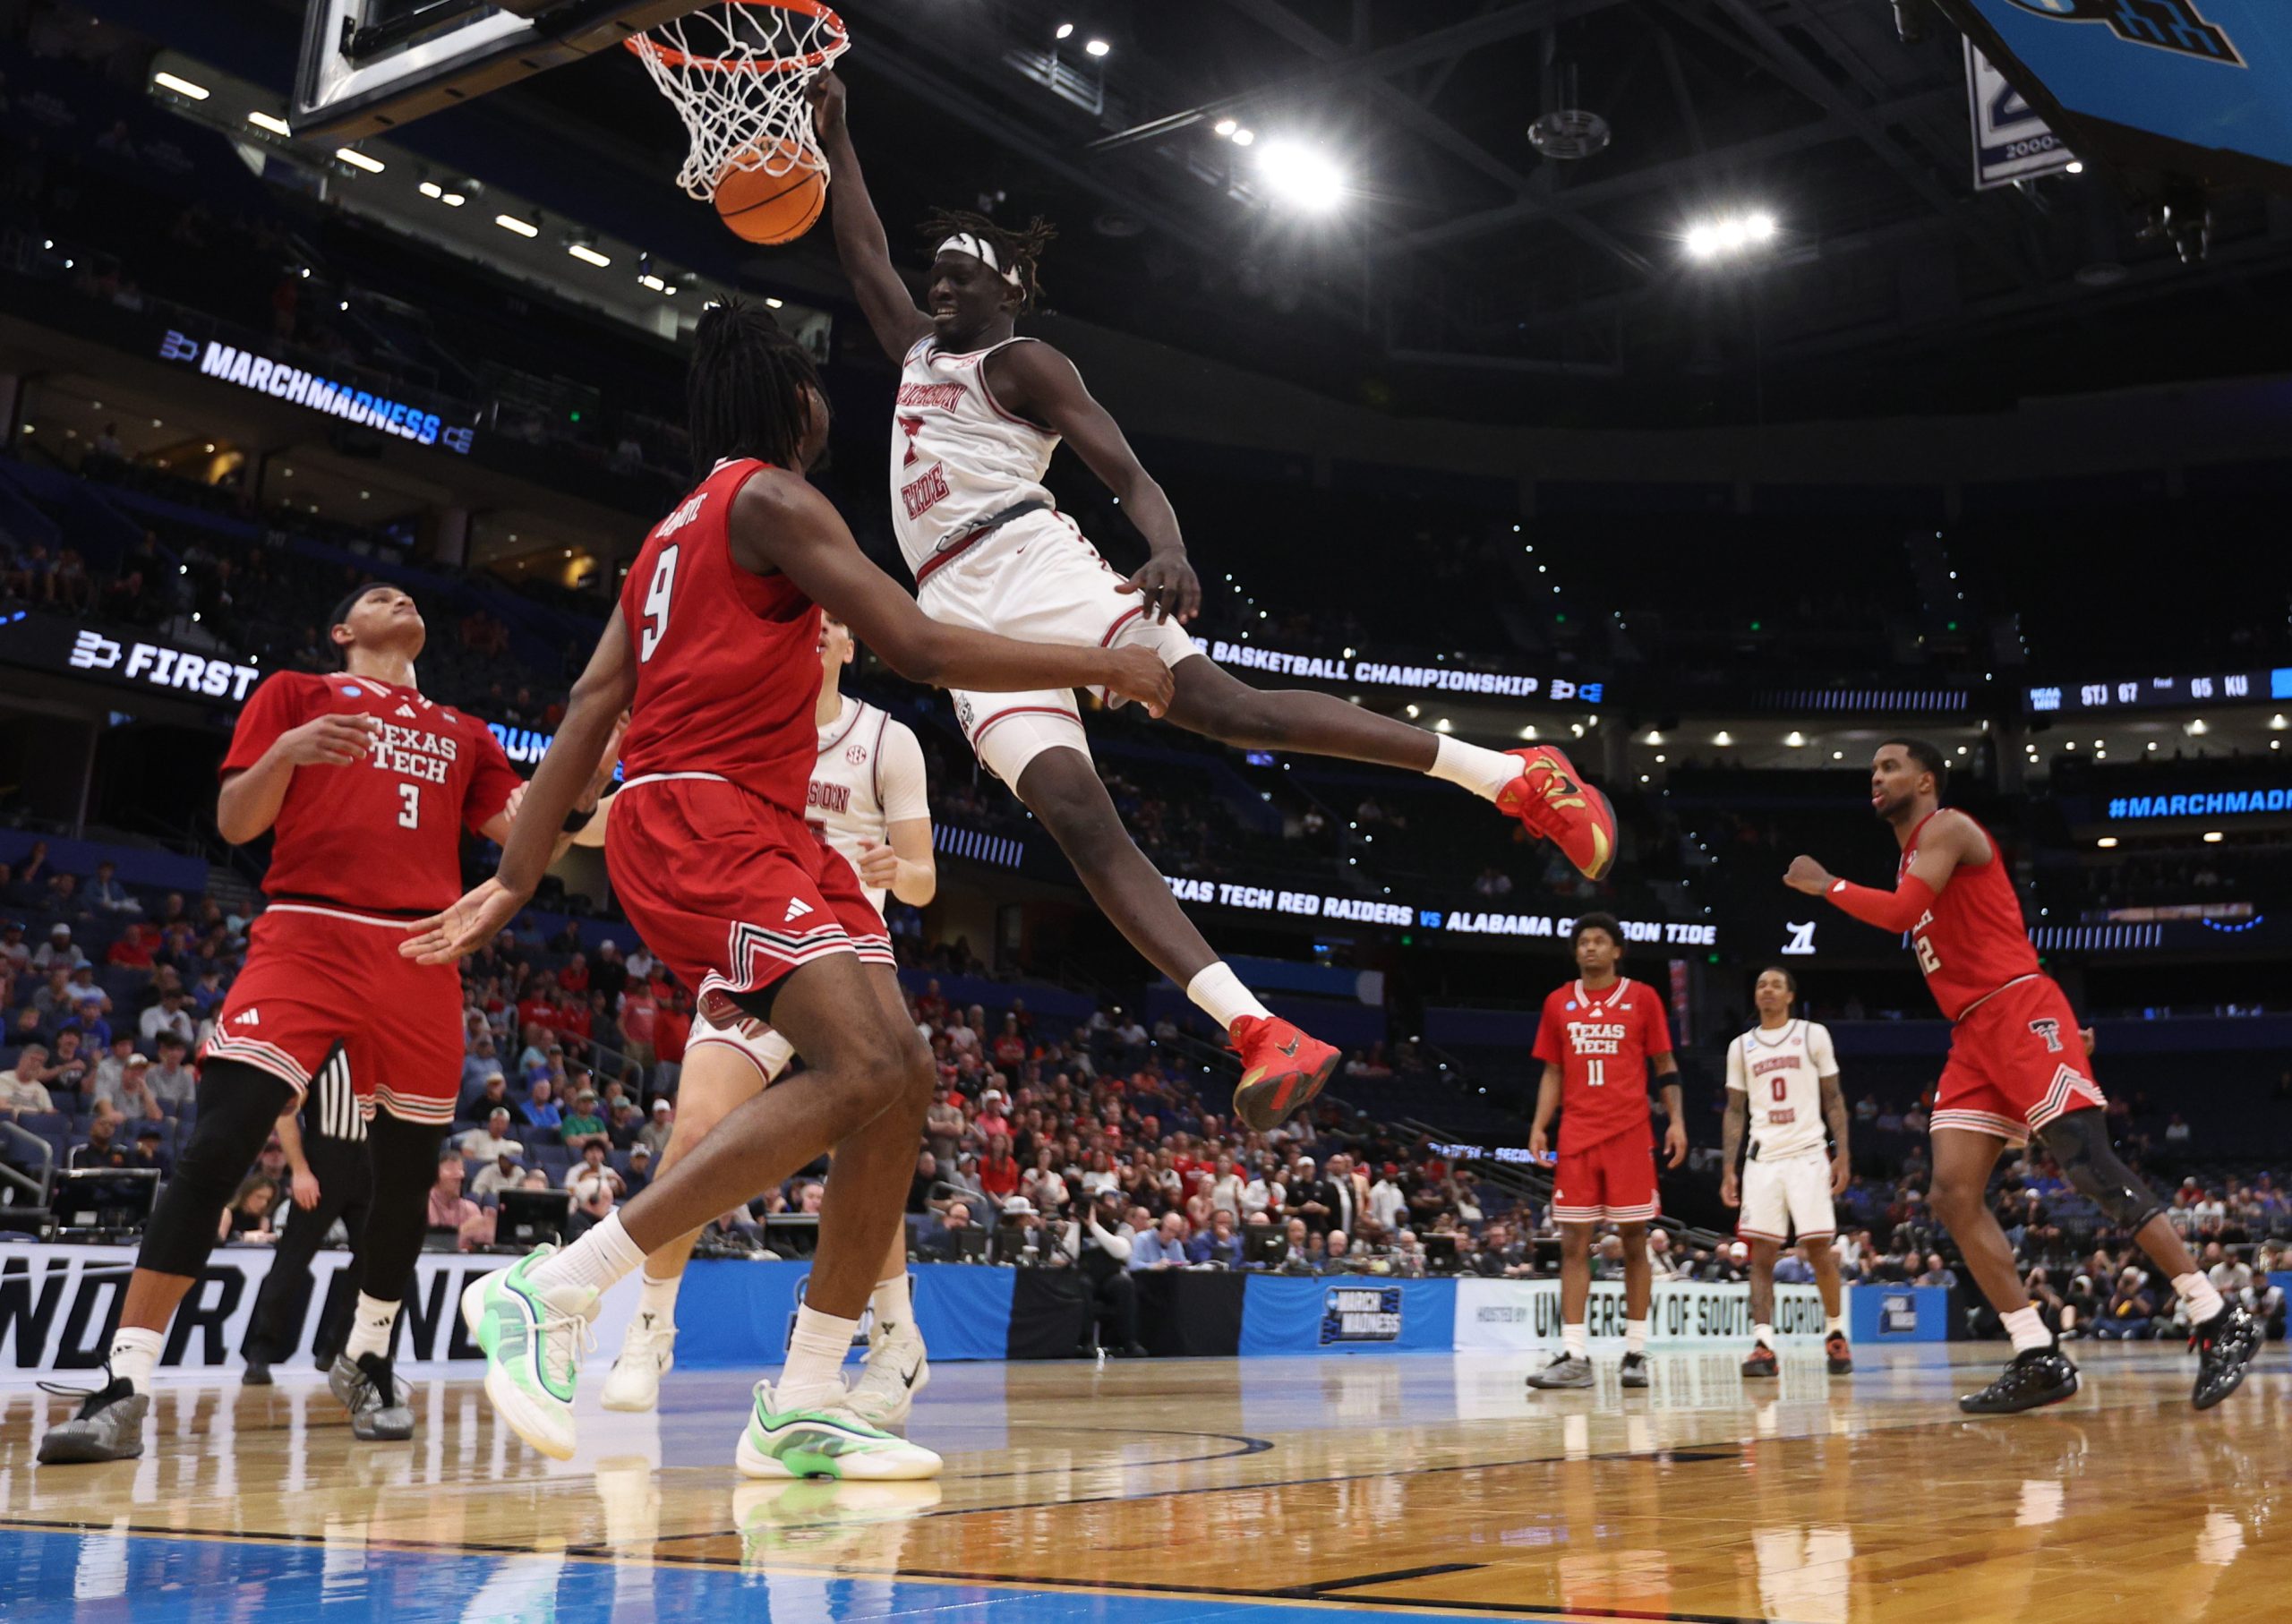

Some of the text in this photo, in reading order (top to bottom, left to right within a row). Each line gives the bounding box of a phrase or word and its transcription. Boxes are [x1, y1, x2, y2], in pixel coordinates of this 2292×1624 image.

[200, 340, 440, 446] MARCHMADNESS
[901, 461, 950, 521] TIDE
[640, 543, 679, 663] 9
[124, 642, 259, 701] FIRST
[1211, 641, 1349, 680] BASKETBALL
[1355, 662, 1538, 696] CHAMPIONSHIP
[2081, 683, 2108, 706] STJ
[2225, 675, 2248, 697] KU
[370, 740, 448, 784] TECH
[398, 782, 420, 830] 3
[1164, 876, 1716, 944] XAS TECH RED RAIDERS VS ALABAMA CSON TIDE
[1567, 1021, 1626, 1039] TEXAS
[1572, 1037, 1618, 1055] TECH
[1587, 1059, 1604, 1086] 11
[1772, 1077, 1786, 1102] 0
[1669, 1295, 1690, 1336] OF
[1771, 1295, 1827, 1335] LORID
